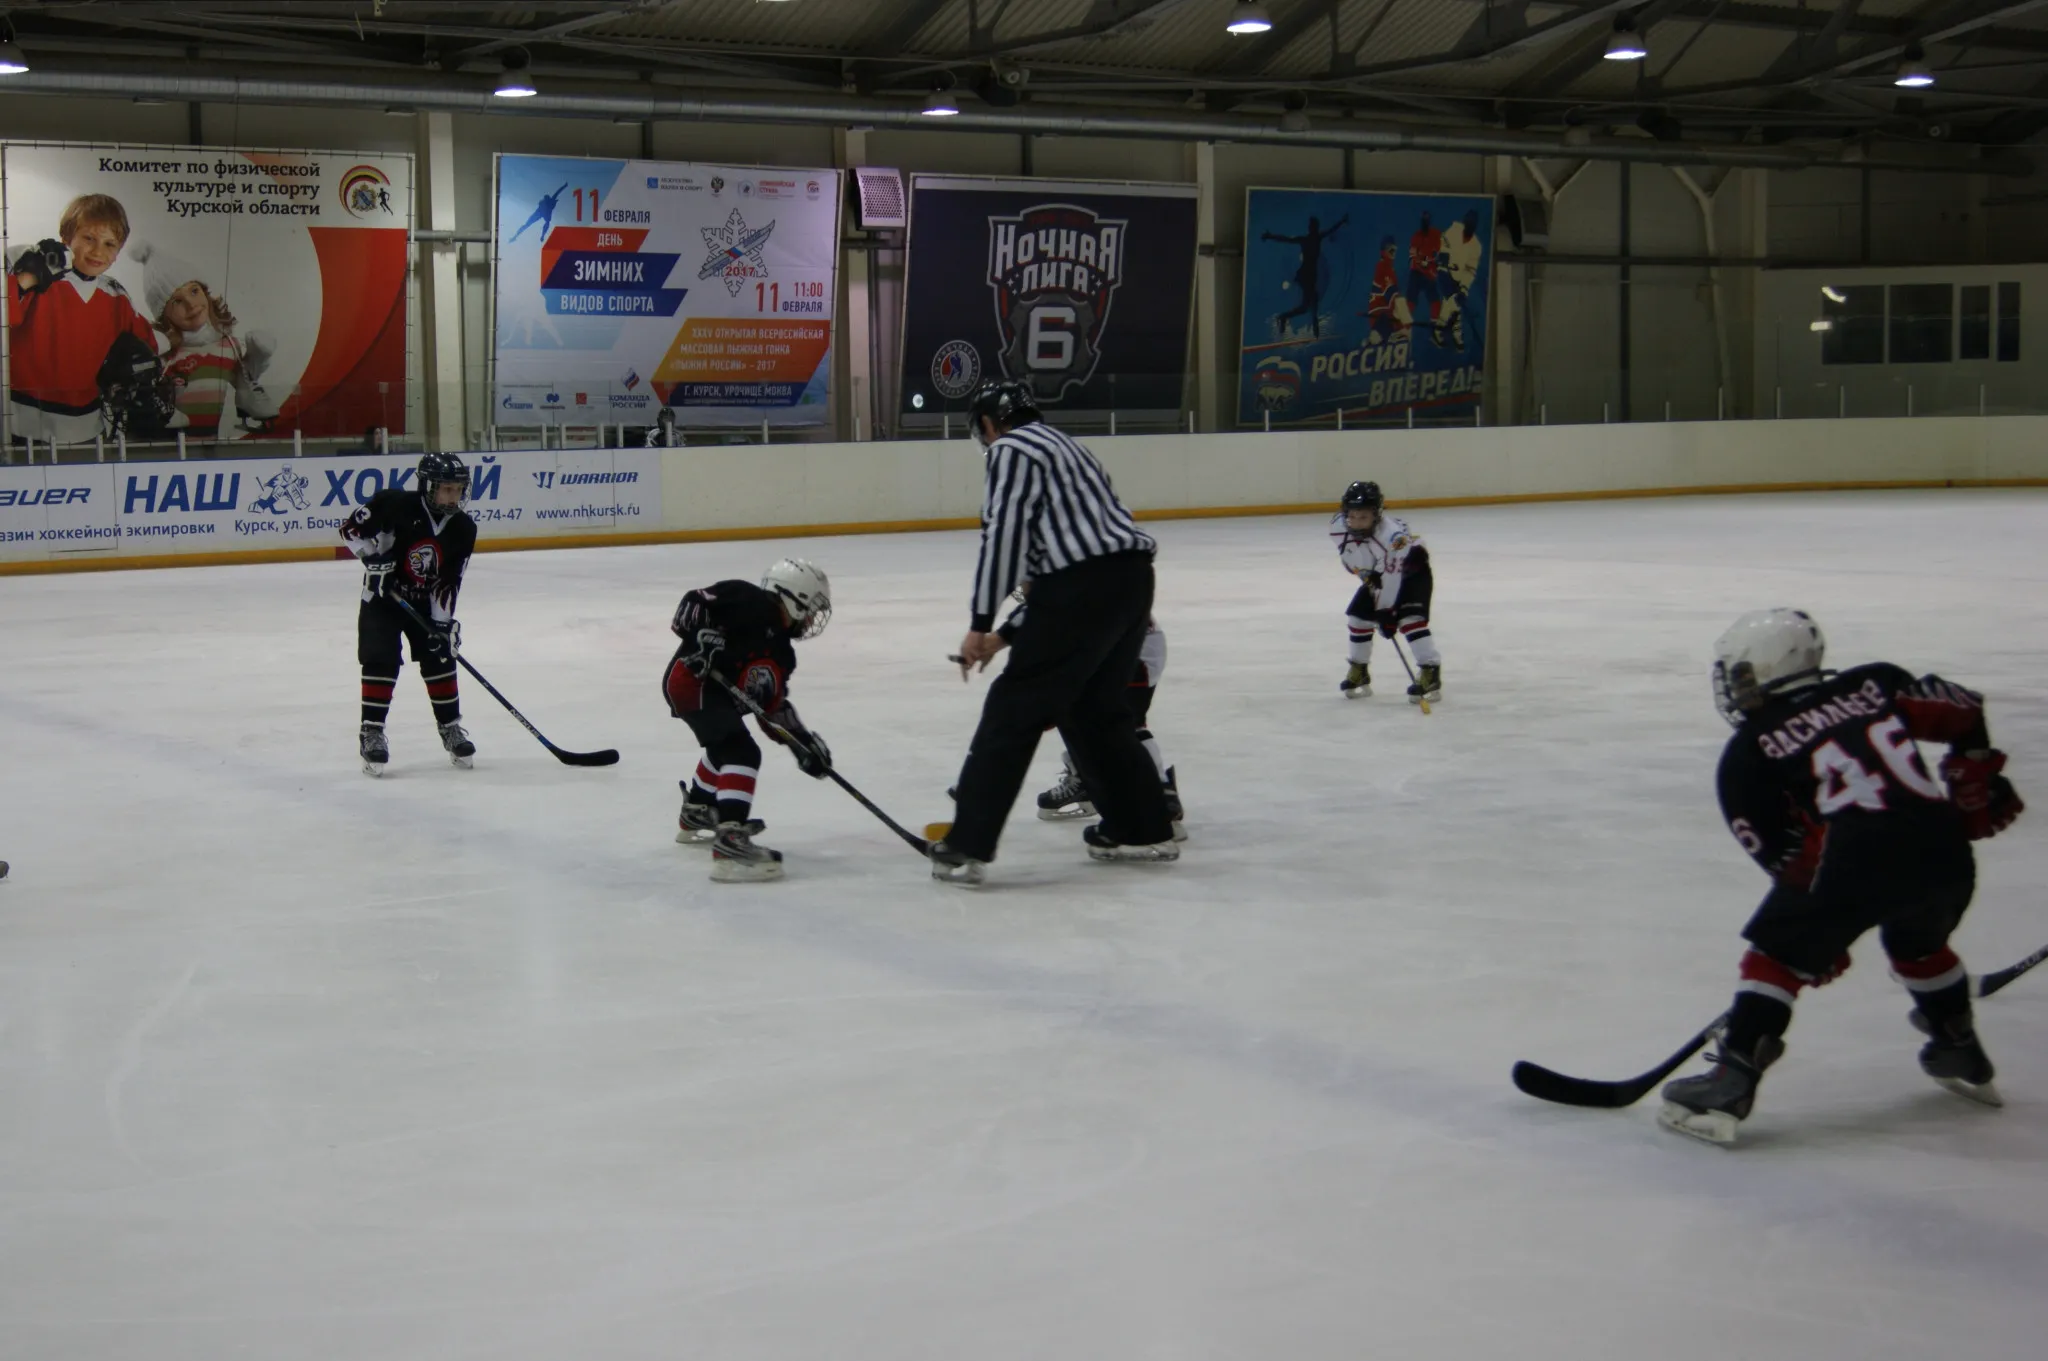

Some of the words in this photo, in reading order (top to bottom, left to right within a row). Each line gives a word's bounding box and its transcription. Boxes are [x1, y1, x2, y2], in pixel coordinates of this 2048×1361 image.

[99, 158, 182, 174] Комитет
[187, 162, 209, 175] по
[214, 158, 320, 179] физической
[153, 180, 236, 197] культуре
[242, 183, 252, 194] и
[258, 183, 320, 199] спорту
[167, 199, 243, 216] Курской
[249, 200, 320, 215] области
[572, 188, 599, 223] 11
[603, 209, 650, 224] ФЕВРАЛЯ
[597, 232, 623, 247] ДЕНЬ
[994, 224, 1118, 281] НОЧНАЯ
[574, 260, 644, 282] ЗИМНИХ
[725, 266, 755, 278] 2017
[1021, 259, 1089, 294] ЛИГА
[755, 282, 778, 313] 11
[794, 282, 823, 298] 11:00
[560, 294, 604, 312] ВИДОВ
[608, 295, 654, 313] СПОРТА
[782, 300, 823, 313] ФЕВРАЛЯ
[1027, 306, 1076, 369] 6
[123, 472, 241, 514] НАШ
[320, 456, 502, 507] ХОКЙ
[560, 471, 639, 485] WARRIOR
[536, 503, 640, 520] www.nhkursk.ru
[39, 524, 121, 541] хоккейной
[126, 522, 215, 538] экипировки
[235, 519, 279, 535] Курск,
[283, 520, 303, 534] ул.
[1811, 713, 1949, 815] 46
